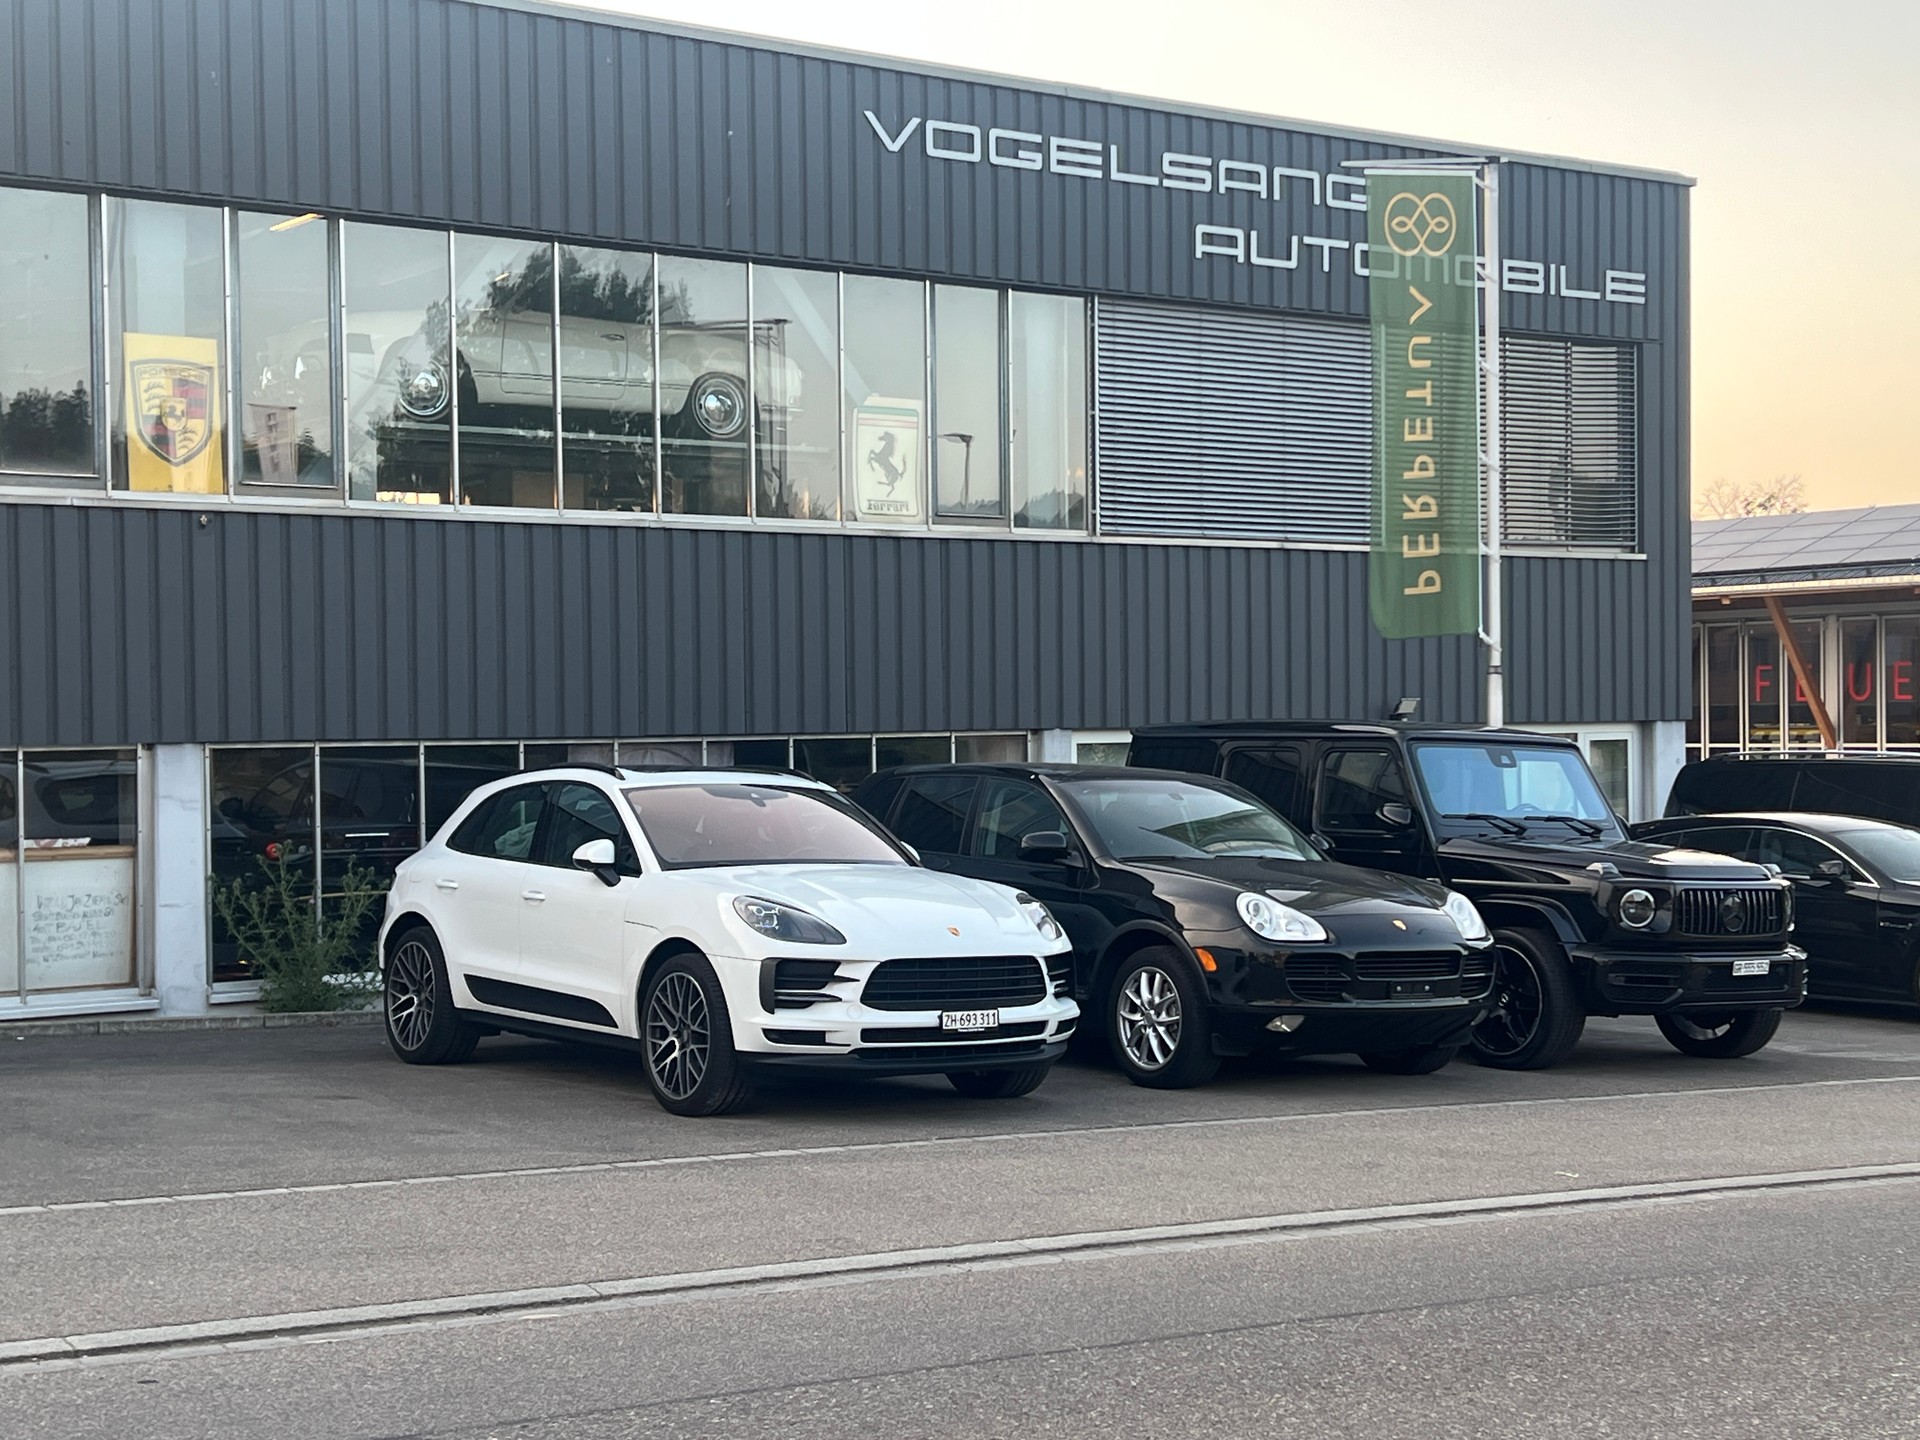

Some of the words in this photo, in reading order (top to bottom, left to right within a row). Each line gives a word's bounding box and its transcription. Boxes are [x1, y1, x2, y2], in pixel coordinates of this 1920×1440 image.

[863, 110, 1371, 212] VOGELSANG
[1195, 224, 1646, 304] AUTOMOBILE
[980, 1011, 996, 1026] 311
